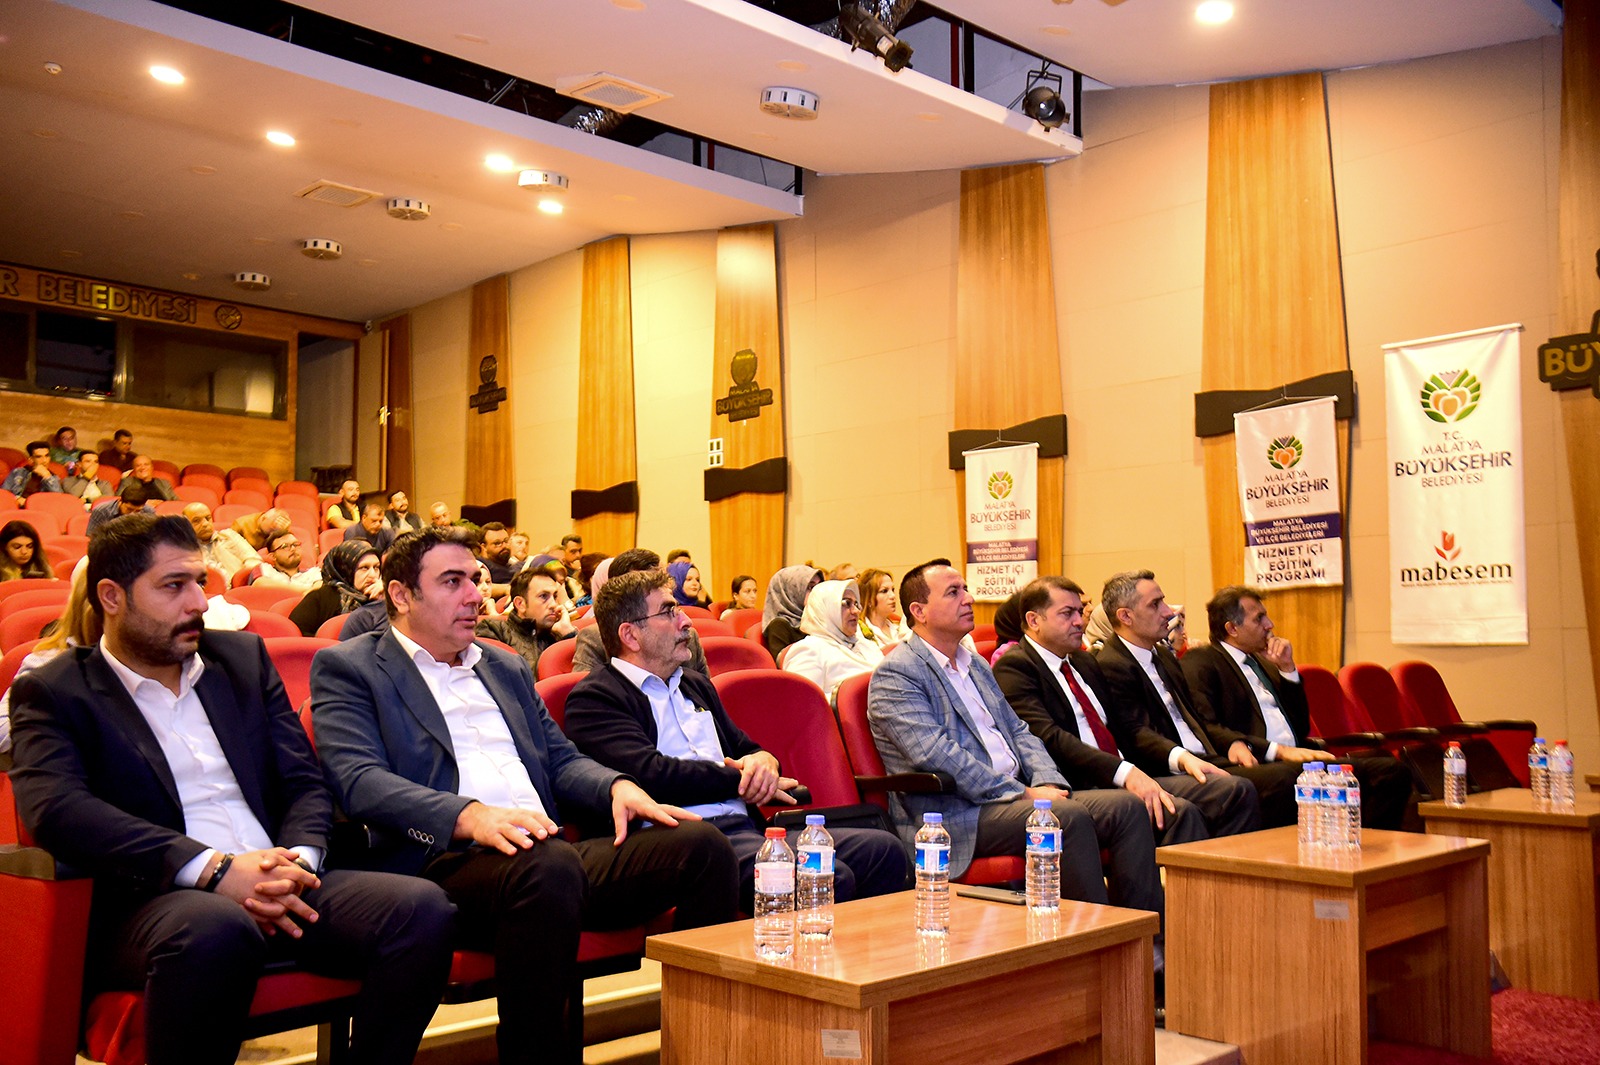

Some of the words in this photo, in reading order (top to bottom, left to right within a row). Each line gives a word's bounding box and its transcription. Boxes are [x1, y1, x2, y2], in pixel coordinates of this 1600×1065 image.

[1442, 431, 1463, 440] T.C.
[1421, 440, 1482, 455] MALATYA
[1264, 470, 1309, 482] MALATYA
[1256, 568, 1325, 583] PROGRAMI
[1401, 561, 1512, 582] mabesem
